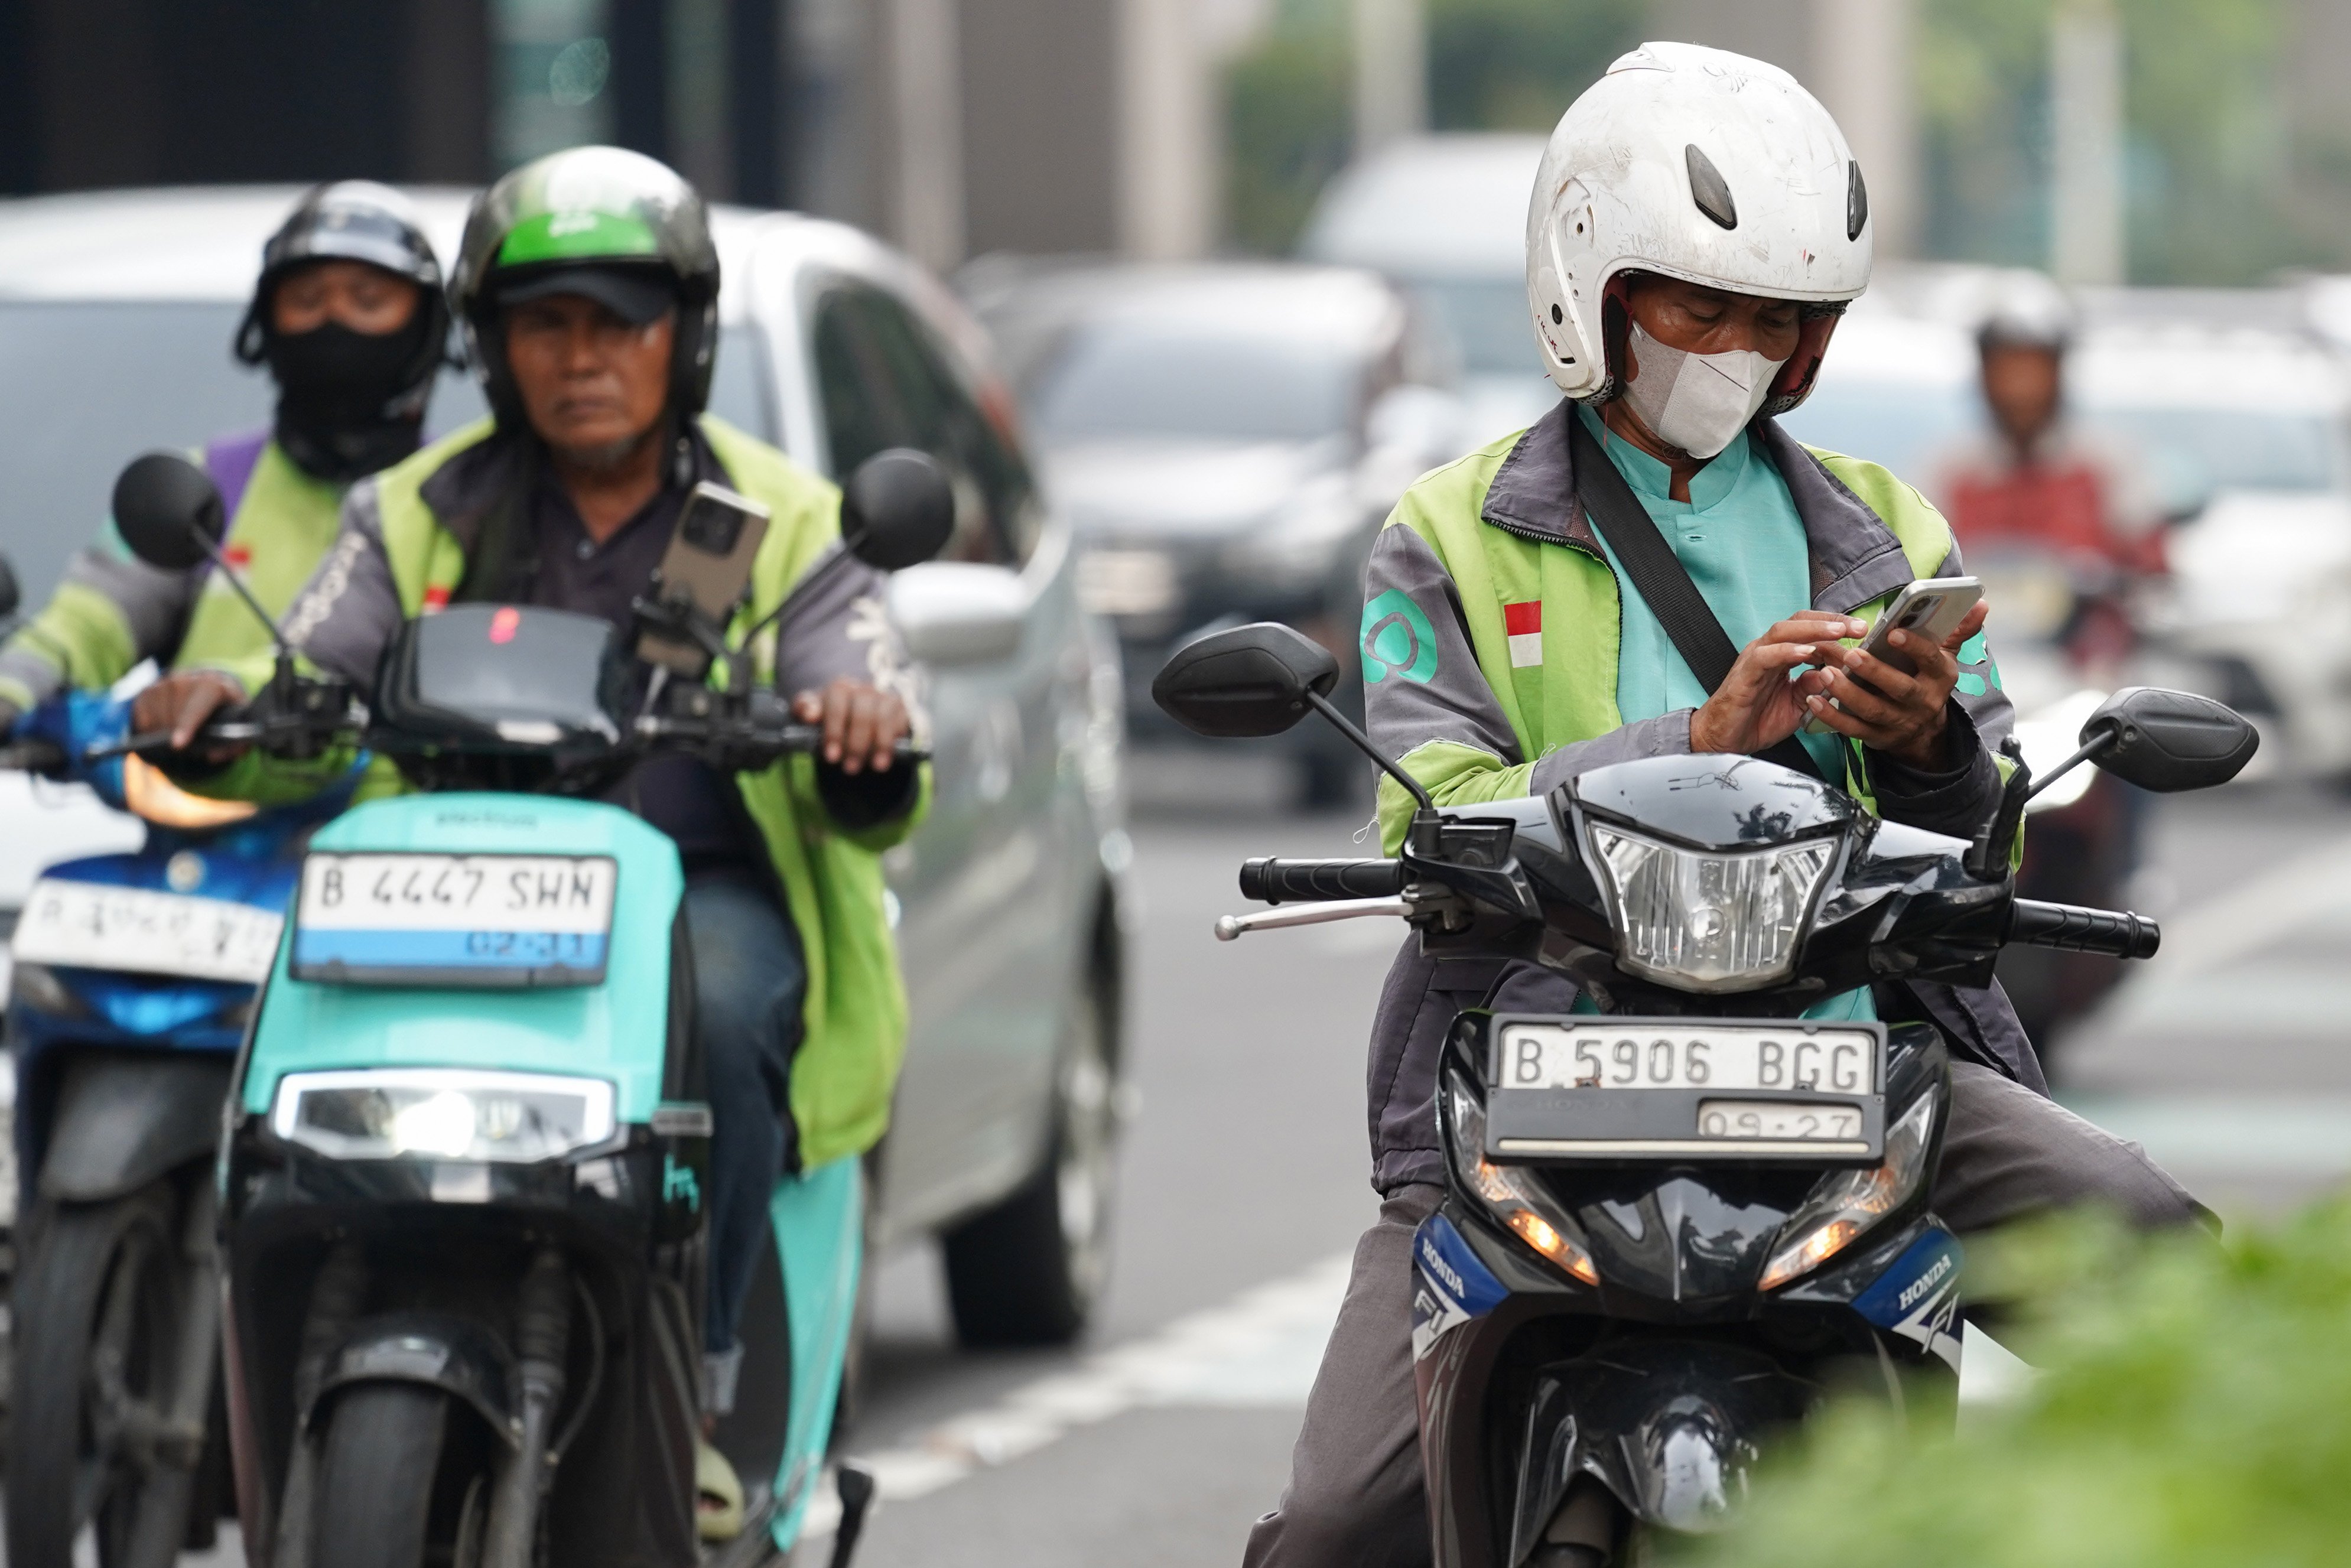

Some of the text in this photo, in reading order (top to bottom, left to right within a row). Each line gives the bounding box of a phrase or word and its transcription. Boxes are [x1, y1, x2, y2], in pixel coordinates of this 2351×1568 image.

[321, 868, 593, 909] B 4447 SHN
[1516, 1038, 1858, 1090] B 5906 BGG
[1422, 1237, 1465, 1299] HONDA
[1898, 1254, 1952, 1312] HONDA
